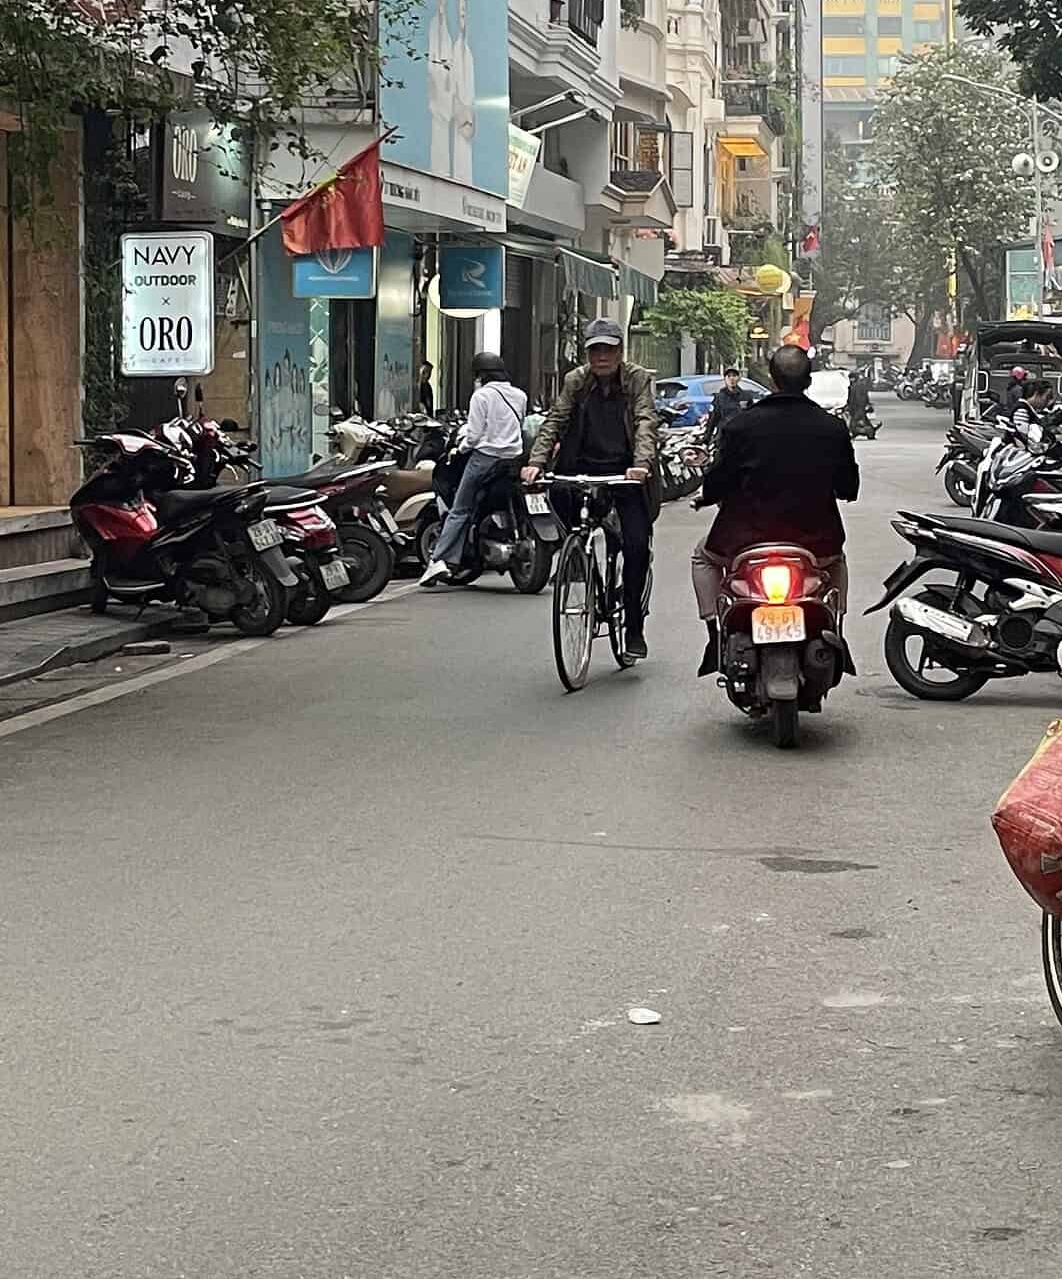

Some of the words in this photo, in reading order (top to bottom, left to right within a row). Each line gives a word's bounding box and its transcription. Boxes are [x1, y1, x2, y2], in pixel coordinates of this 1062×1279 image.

[134, 245, 195, 265] NAVY
[134, 275, 197, 286] OUTDOOR
[139, 316, 193, 351] ORO
